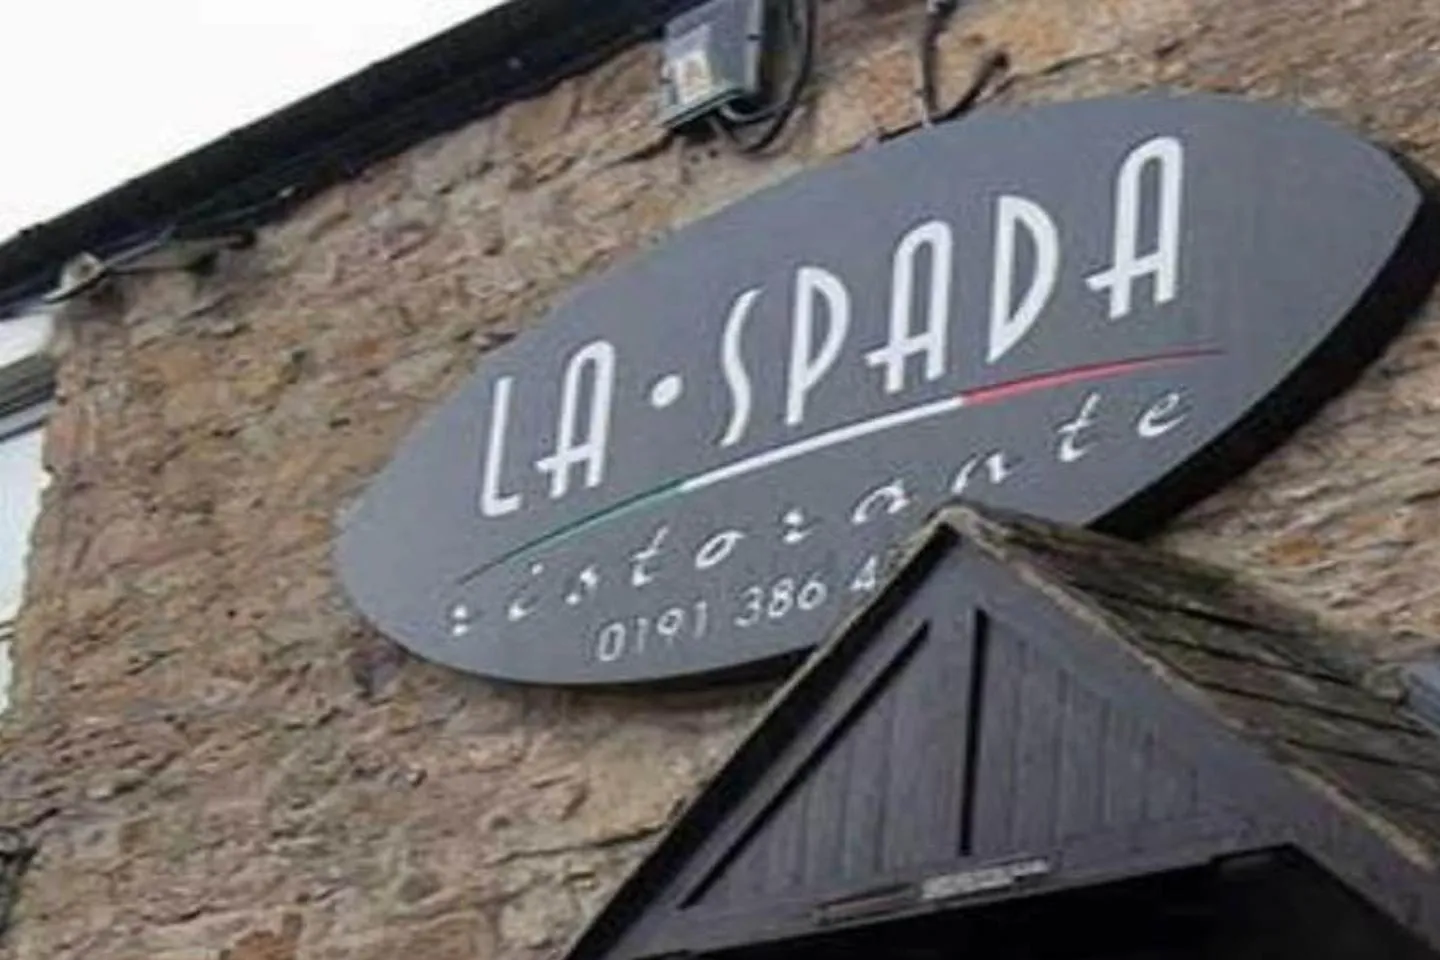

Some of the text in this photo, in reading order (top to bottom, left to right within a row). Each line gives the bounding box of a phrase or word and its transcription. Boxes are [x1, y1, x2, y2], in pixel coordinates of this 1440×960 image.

[480, 135, 1184, 518] LA SPADA
[600, 575, 828, 662] 0191 386
